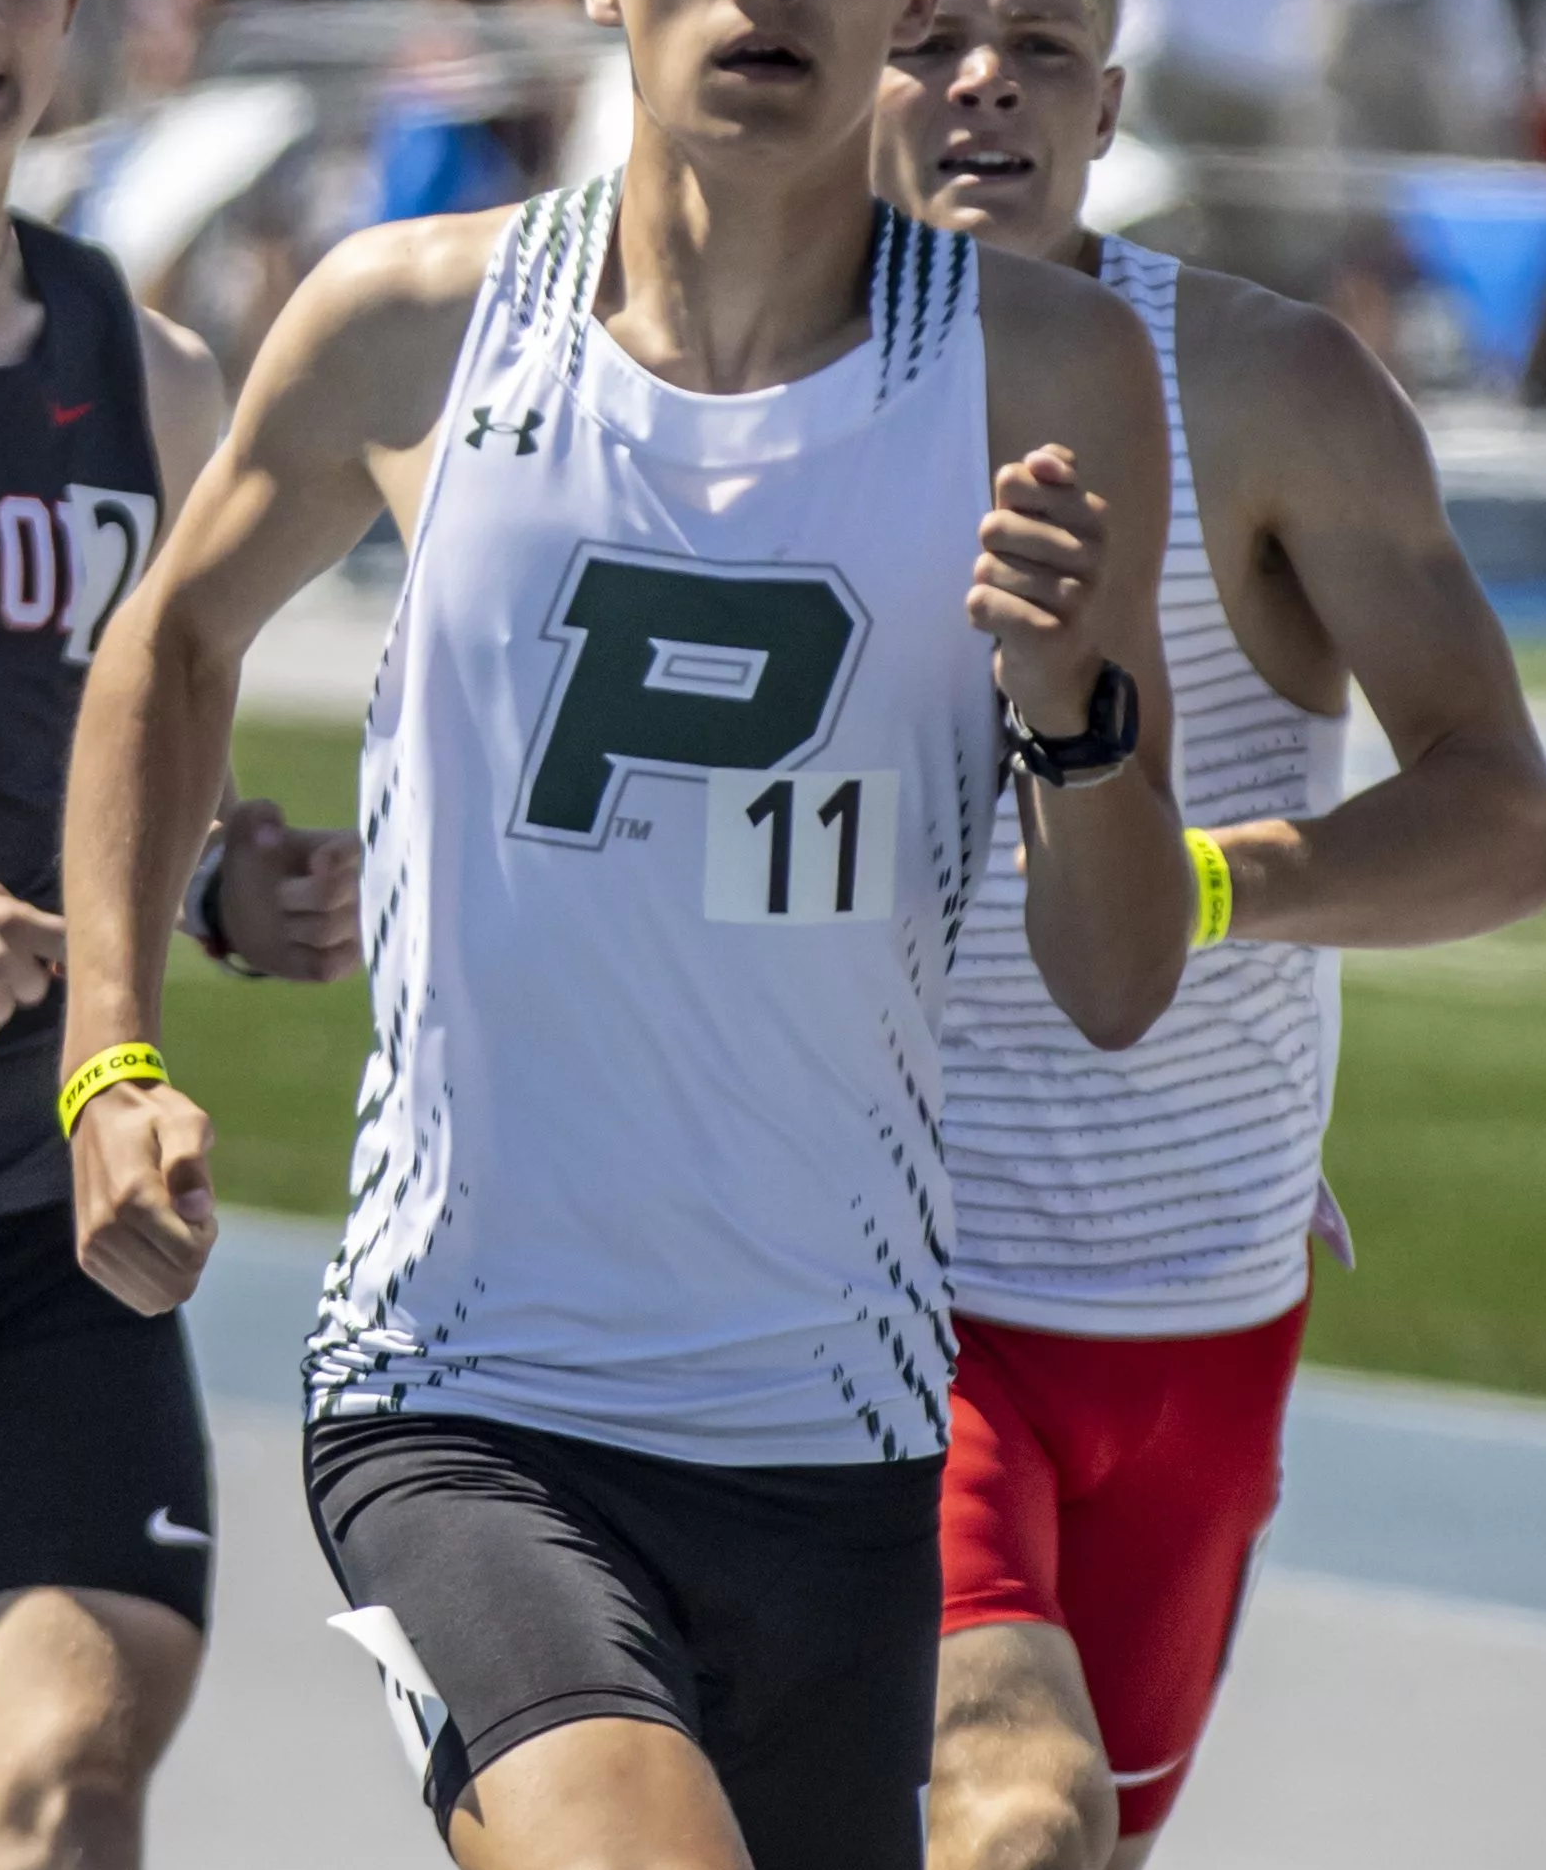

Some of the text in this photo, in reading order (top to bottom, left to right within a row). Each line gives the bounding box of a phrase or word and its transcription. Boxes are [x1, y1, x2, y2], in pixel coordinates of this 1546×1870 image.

[505, 539, 875, 853] P
[615, 816, 654, 841] TM
[745, 778, 863, 915] 11
[65, 1063, 105, 1110] STATE
